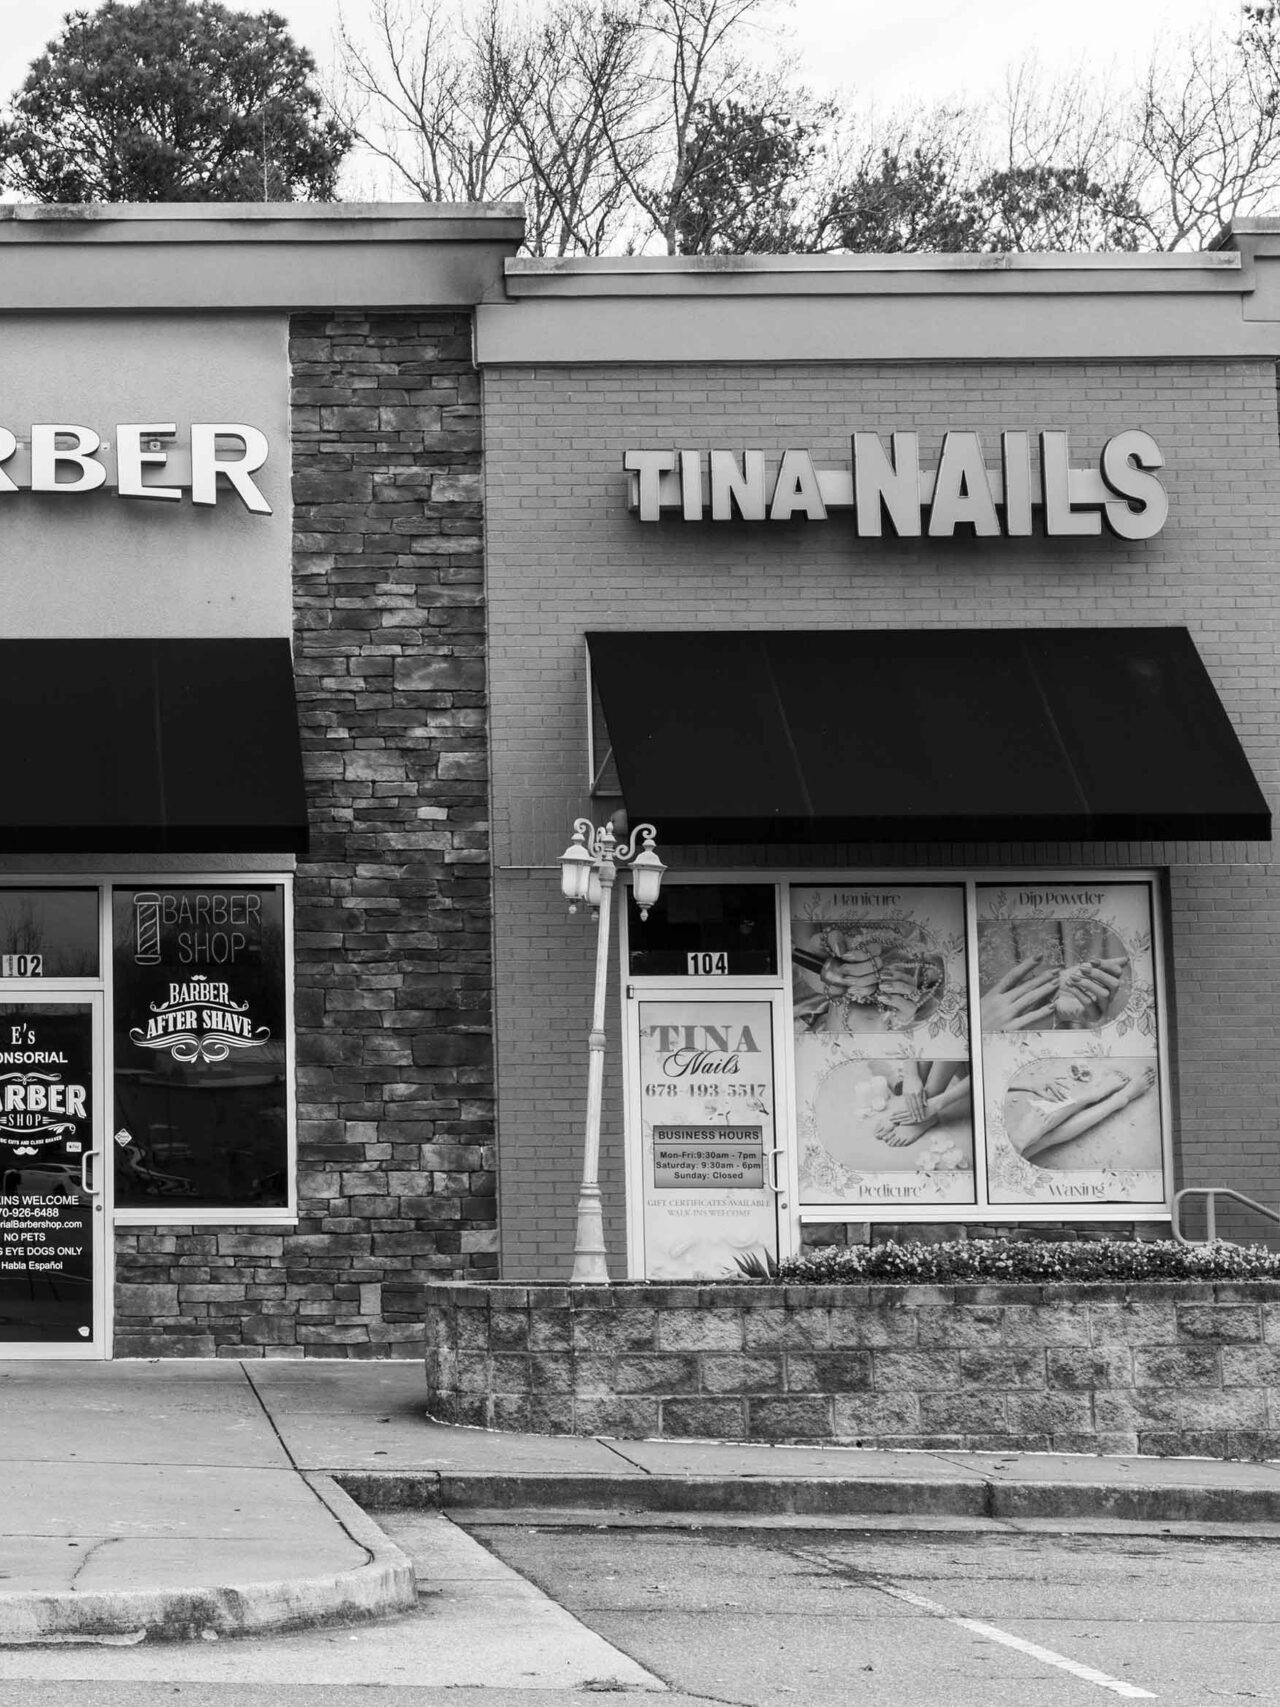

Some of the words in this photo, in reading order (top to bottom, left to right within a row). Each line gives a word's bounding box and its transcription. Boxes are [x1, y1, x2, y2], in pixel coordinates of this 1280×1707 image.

[623, 448, 828, 522] TINA
[851, 429, 1169, 540] NAILS
[1019, 891, 1043, 908] Dip
[1045, 891, 1104, 905] Powder
[162, 894, 261, 925] BARBER
[178, 932, 246, 963] SHOP
[8, 955, 41, 977] 102
[690, 953, 727, 974] 104
[169, 982, 230, 1005] BARBER
[146, 1010, 198, 1039] AFTER
[202, 1010, 252, 1038] SHAVE
[10, 1022, 36, 1045] E's
[649, 1024, 762, 1053] TINA
[662, 1046, 741, 1078] Nails
[8, 1113, 42, 1127] SHOP
[658, 1130, 715, 1140] BUSINESS
[719, 1130, 760, 1140] HOURS
[737, 1151, 757, 1161] 7pm
[656, 1161, 699, 1171] Saturday:
[701, 1161, 734, 1169] 9:30am
[742, 1161, 761, 1170] 6pm
[674, 1172, 710, 1180] Sunday:
[1048, 1182, 1105, 1199] Waxing
[21, 1195, 80, 1205] WELCOME
[647, 1199, 667, 1207] GIFT
[668, 1199, 728, 1207] CERTIFICATES
[728, 1199, 771, 1208] AVAILABLE
[708, 1209, 752, 1217] WELCOME
[3, 1232, 19, 1241] NO
[21, 1232, 46, 1241] PETS
[5, 1247, 25, 1256] EYE
[27, 1247, 55, 1256] DOGS
[57, 1247, 83, 1256] ONLY
[1, 1261, 26, 1270] Habla
[28, 1261, 63, 1272] Español
